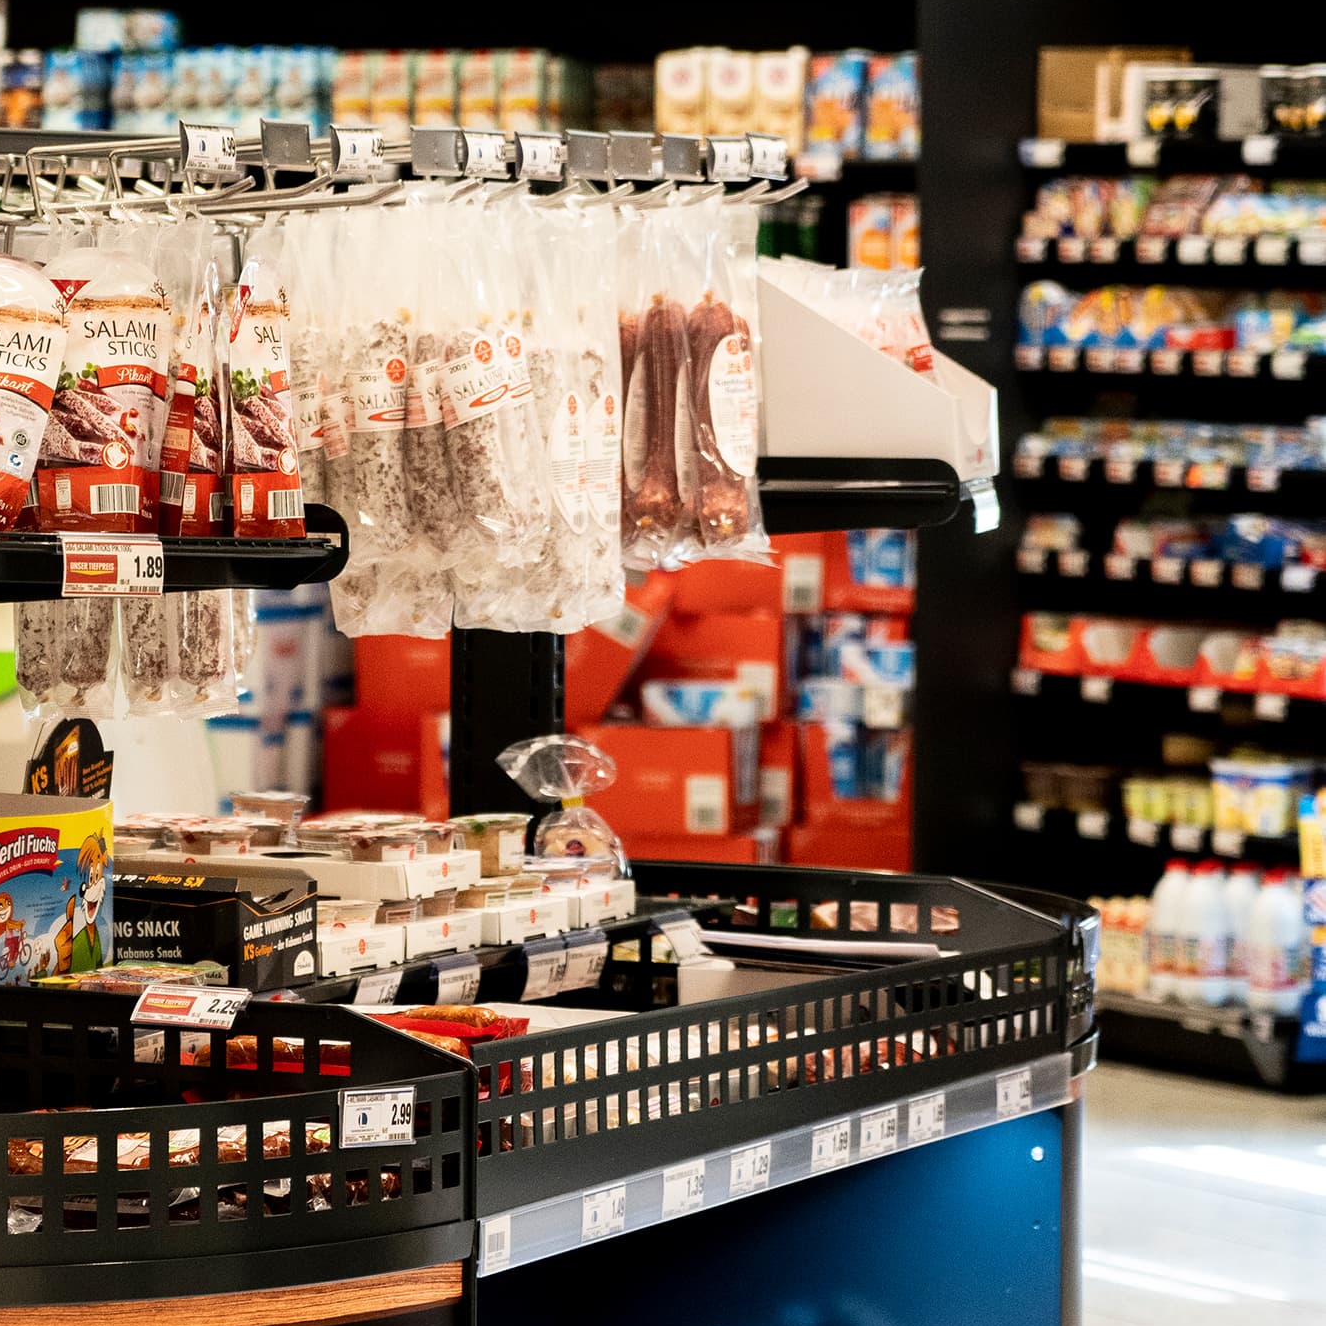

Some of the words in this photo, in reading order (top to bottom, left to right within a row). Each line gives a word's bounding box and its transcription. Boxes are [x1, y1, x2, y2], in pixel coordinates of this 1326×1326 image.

[84, 320, 157, 341] SALAMI
[107, 341, 158, 360] STICKS
[116, 367, 154, 384] Pikant
[70, 561, 88, 570] UNSER
[134, 556, 163, 579] 1.89
[26, 834, 57, 855] Fuchs
[137, 920, 181, 938] SNACK
[243, 922, 264, 942] GAME
[264, 913, 294, 936] WINNING
[294, 907, 313, 928] SNACK
[117, 946, 155, 961] Kabanos
[157, 945, 183, 959] Snack
[207, 998, 241, 1016] 2.29
[391, 1103, 412, 1126] 2.99
